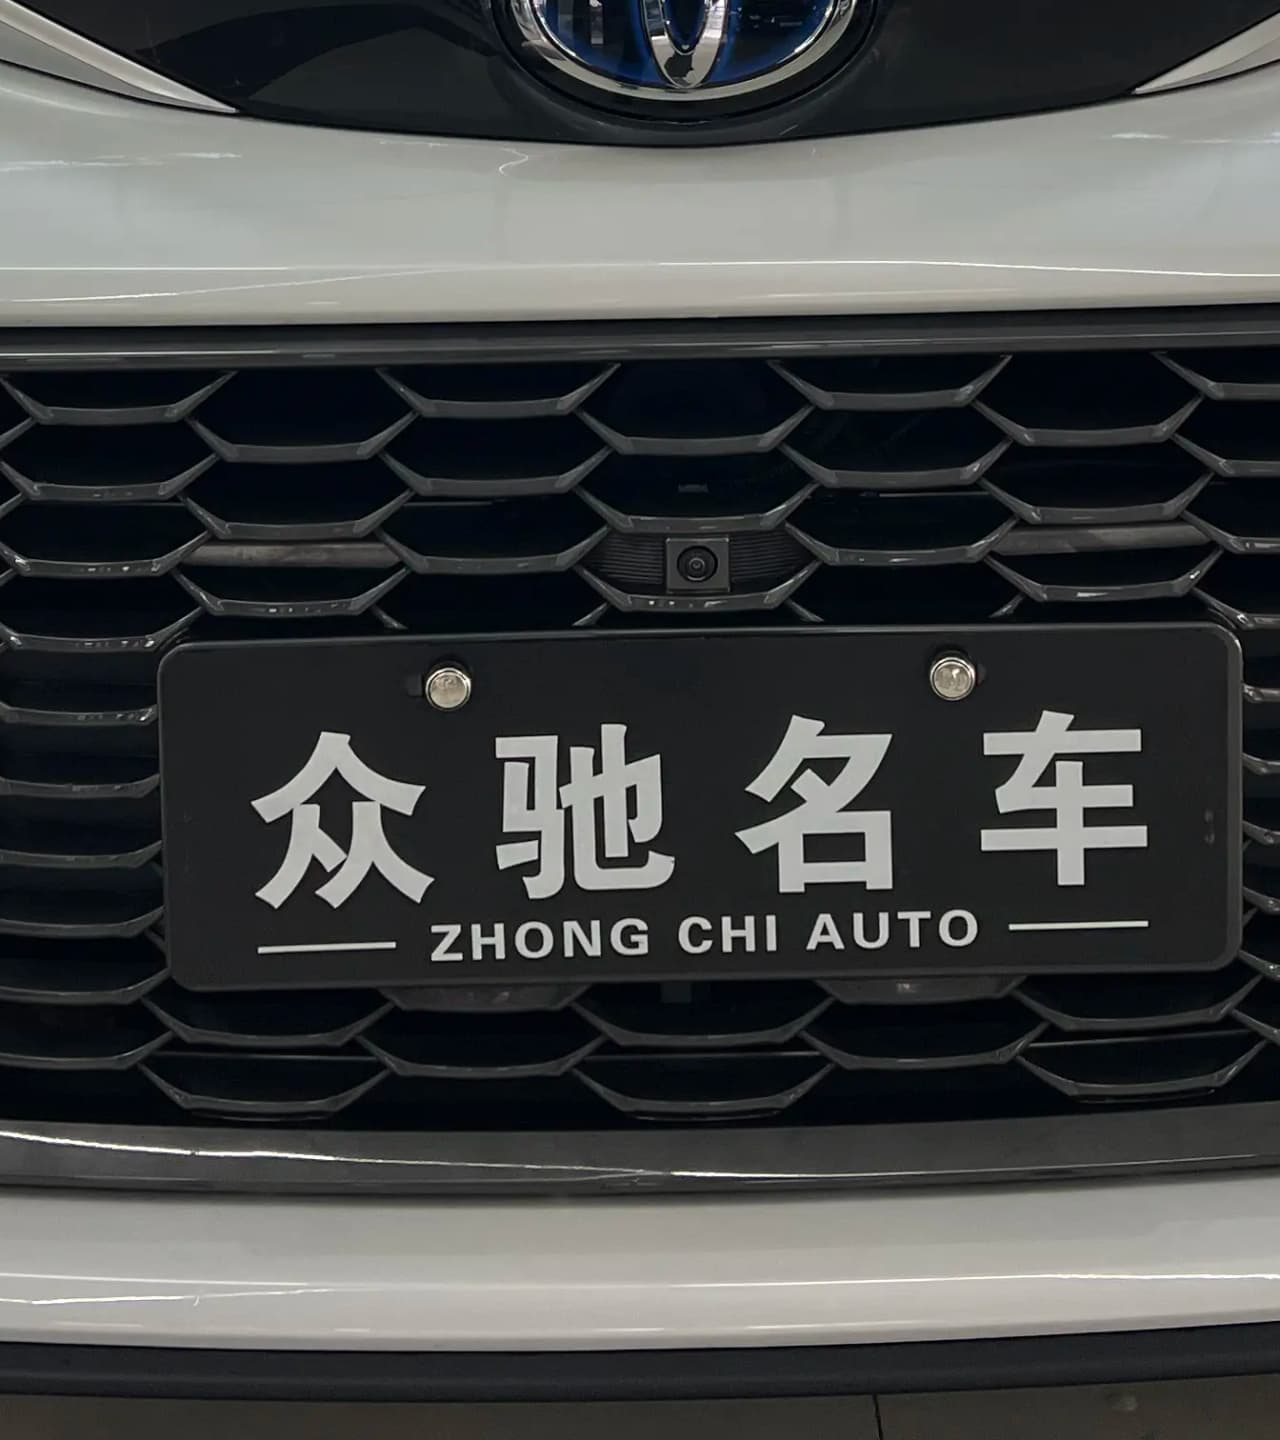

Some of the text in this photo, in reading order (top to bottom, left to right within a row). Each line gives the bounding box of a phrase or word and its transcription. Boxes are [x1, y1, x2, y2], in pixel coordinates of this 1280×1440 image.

[251, 710, 1149, 910] 众驰名车
[430, 909, 980, 962] ZHONG CHI AUTO
